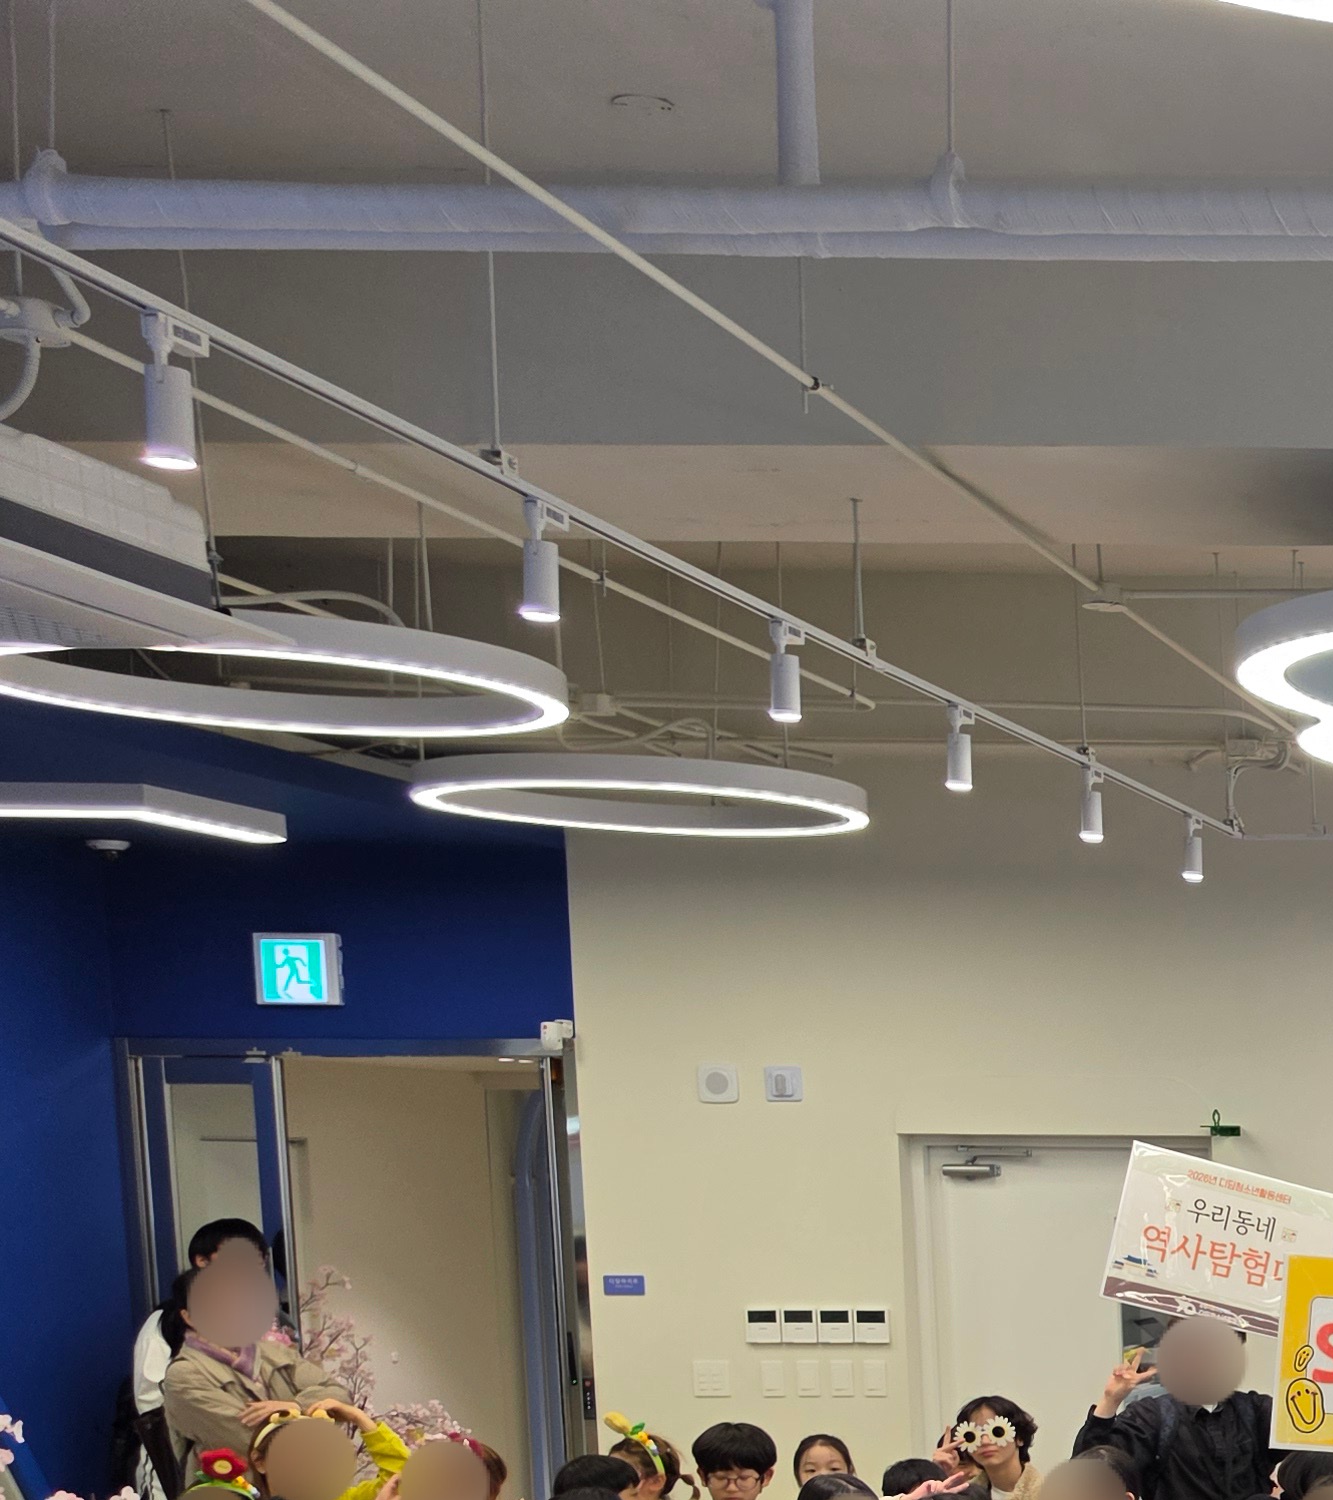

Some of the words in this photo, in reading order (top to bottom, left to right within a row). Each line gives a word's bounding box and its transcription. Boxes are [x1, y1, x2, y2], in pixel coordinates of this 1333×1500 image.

[1187, 1168, 1218, 1186] 2026년
[1218, 1176, 1292, 1205] 디딤청소년활동센터
[1187, 1198, 1278, 1243] 우리동네
